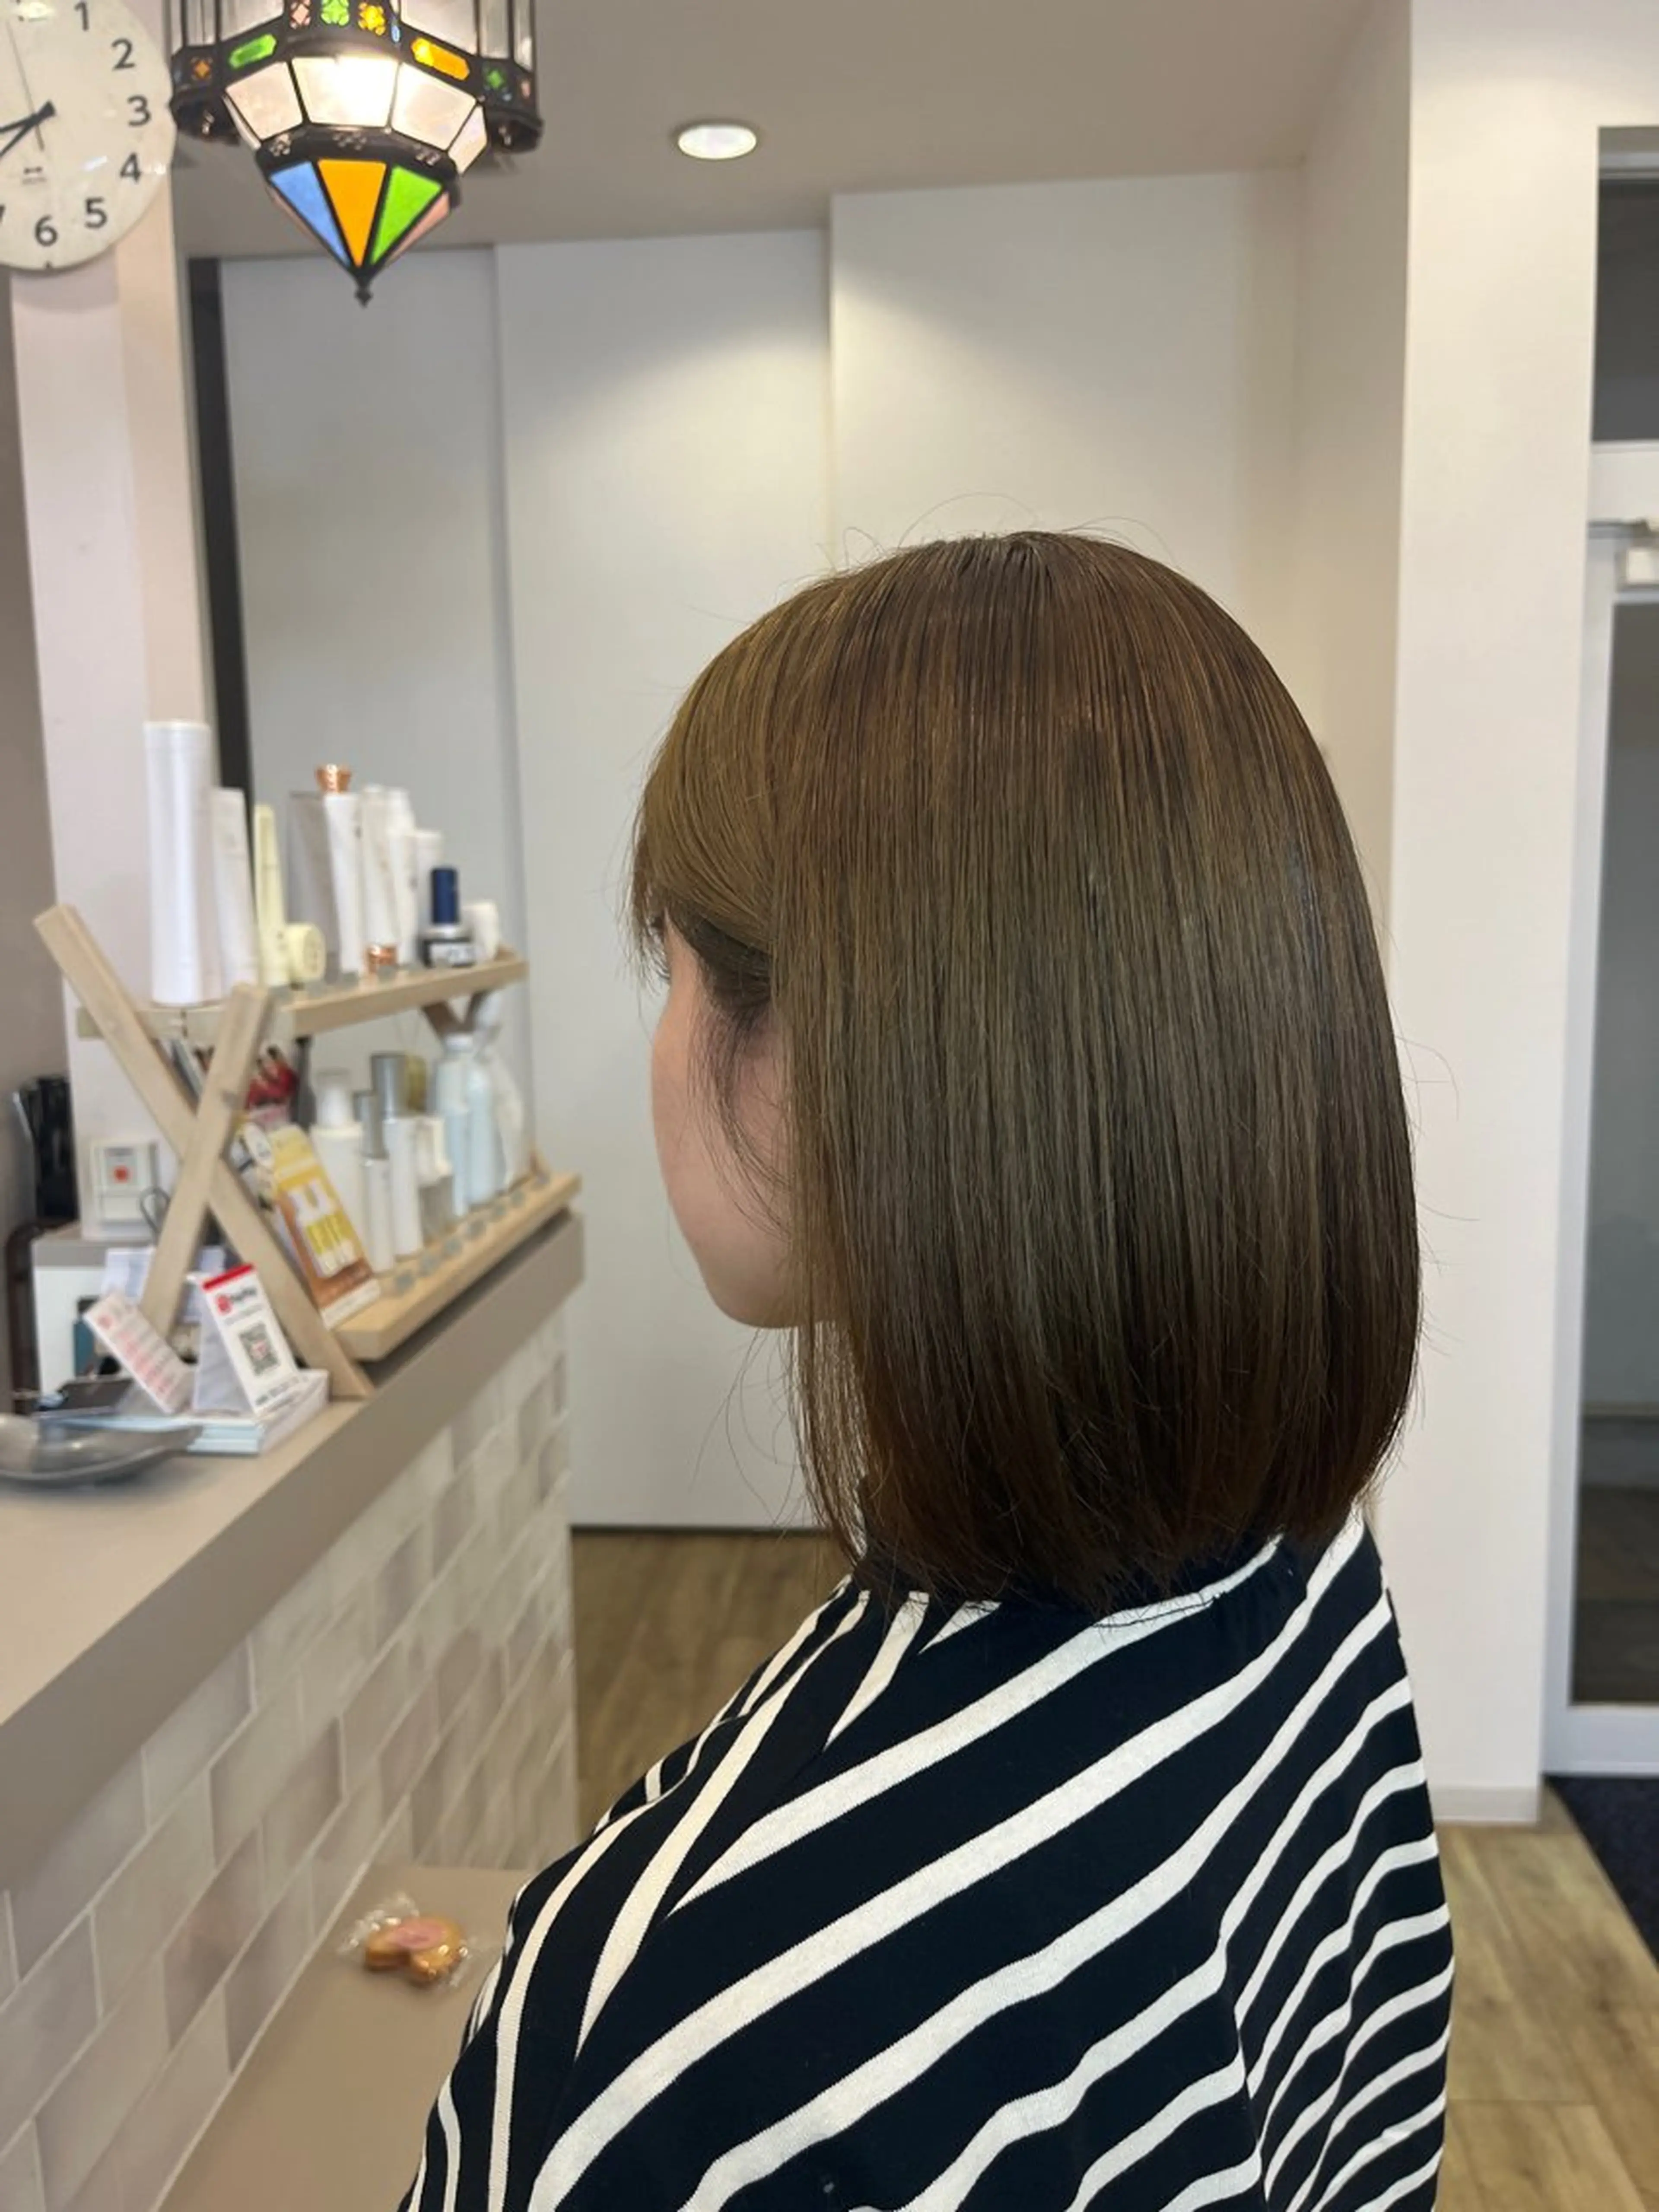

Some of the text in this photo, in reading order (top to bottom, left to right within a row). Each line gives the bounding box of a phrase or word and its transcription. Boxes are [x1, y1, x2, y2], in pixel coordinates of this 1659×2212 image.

[75, 1, 89, 32] 1
[111, 38, 136, 71] 2
[127, 95, 151, 127] 3
[119, 152, 142, 183] 4
[84, 197, 108, 229] 5
[35, 215, 58, 247] 6
